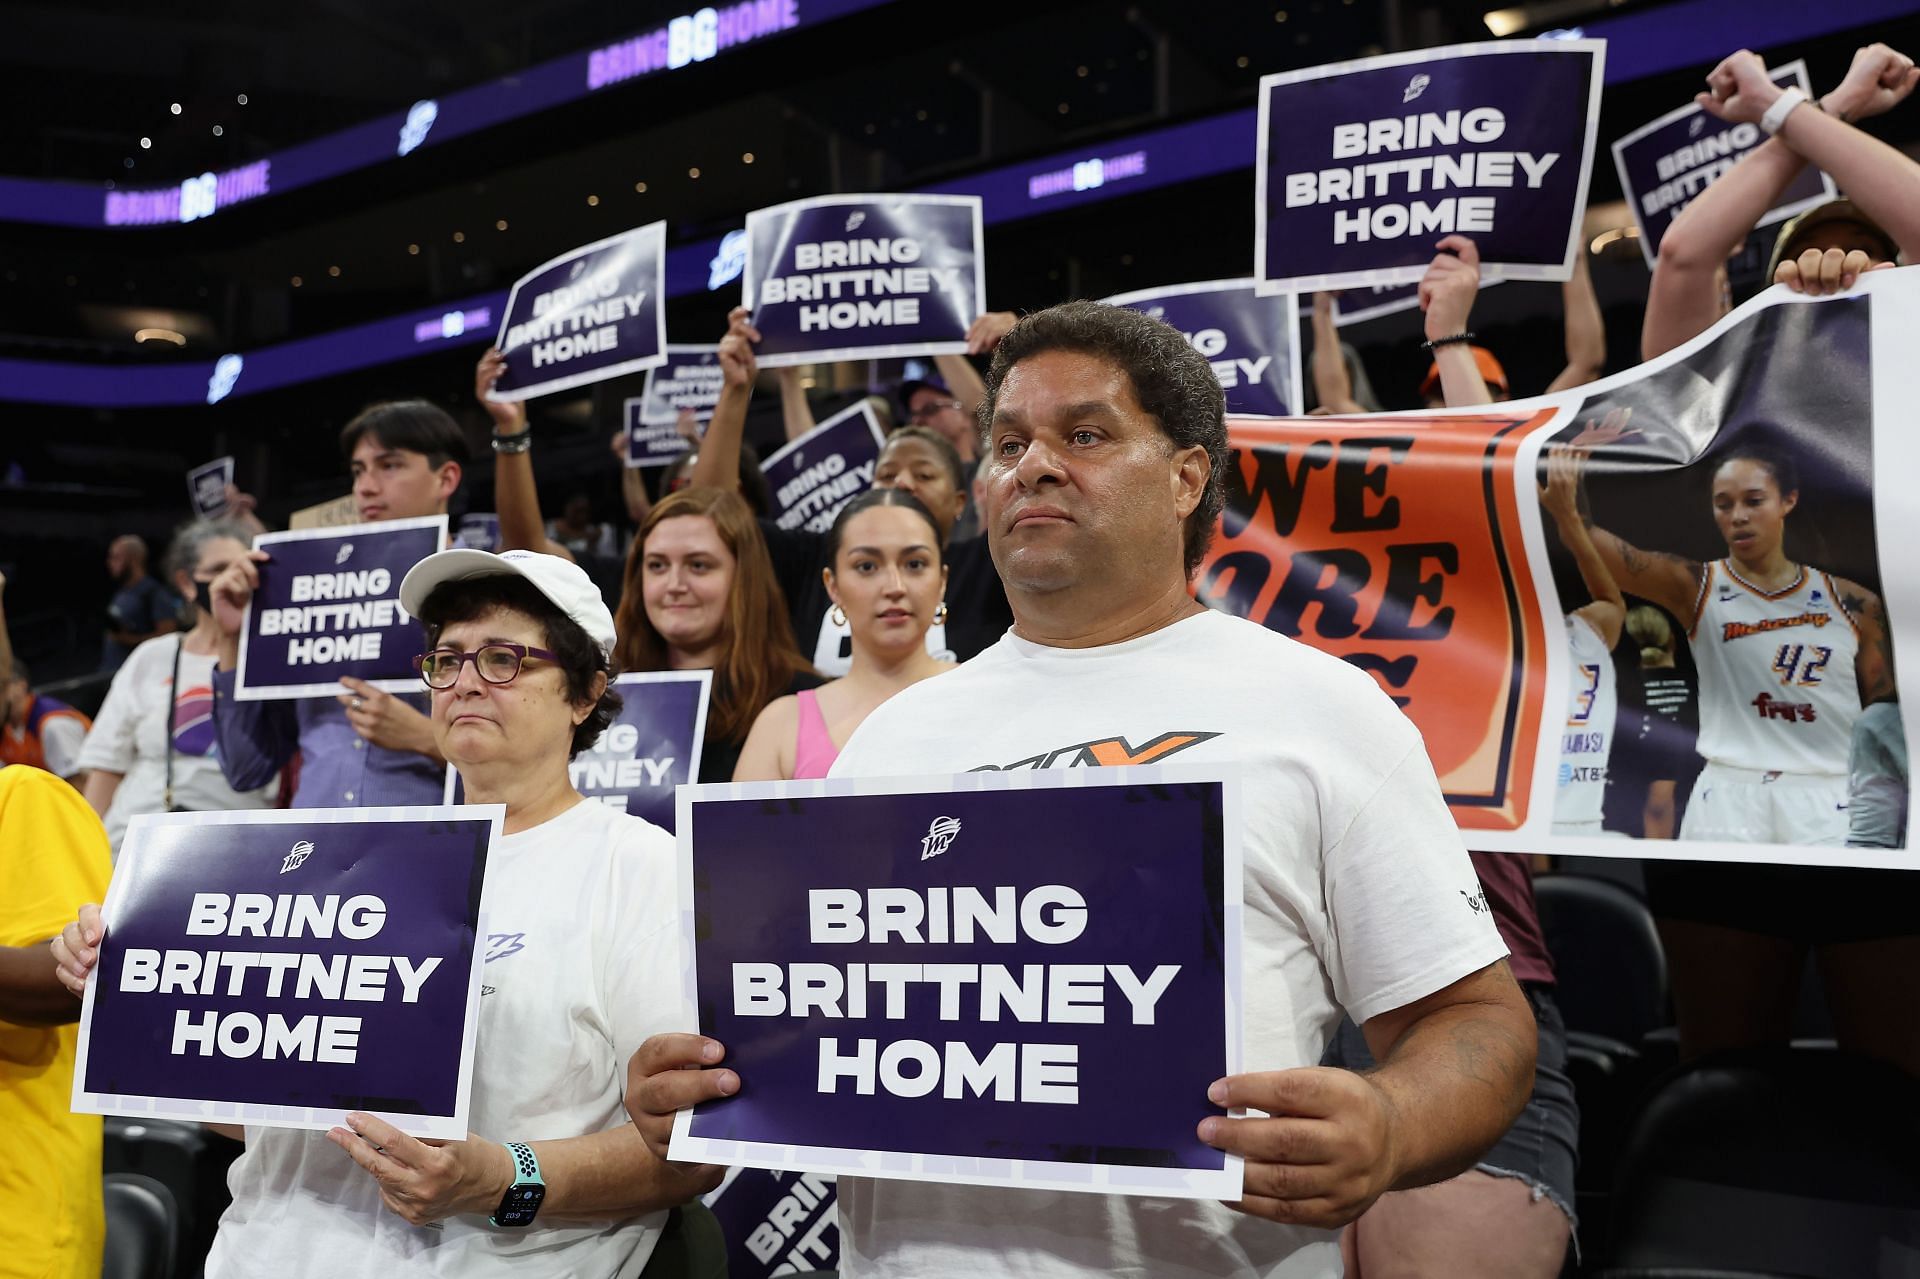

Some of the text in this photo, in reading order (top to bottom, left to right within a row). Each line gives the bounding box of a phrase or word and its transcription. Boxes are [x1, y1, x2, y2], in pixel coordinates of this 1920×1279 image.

[1333, 107, 1506, 159] BRING
[1285, 151, 1561, 208] BRITTNEY
[1333, 197, 1497, 245] HOME
[795, 238, 922, 271] BRING
[532, 274, 620, 318] BRING
[760, 267, 960, 305] BRITTNEY
[505, 290, 646, 349] BRITTNEY
[799, 298, 920, 332] HOME
[531, 325, 618, 369] HOME
[776, 453, 846, 509] BRING
[1221, 435, 1416, 540] WE
[290, 568, 391, 602] BRING
[259, 598, 412, 636] BRITTNEY
[287, 632, 383, 666] HOME
[1771, 644, 1833, 687] 42
[185, 892, 388, 940] BRING
[808, 884, 1089, 945] BRING
[119, 948, 444, 1004] BRITTNEY
[731, 961, 1183, 1026] BRITTNEY
[170, 1008, 363, 1065] HOME
[817, 1036, 1080, 1105] HOME
